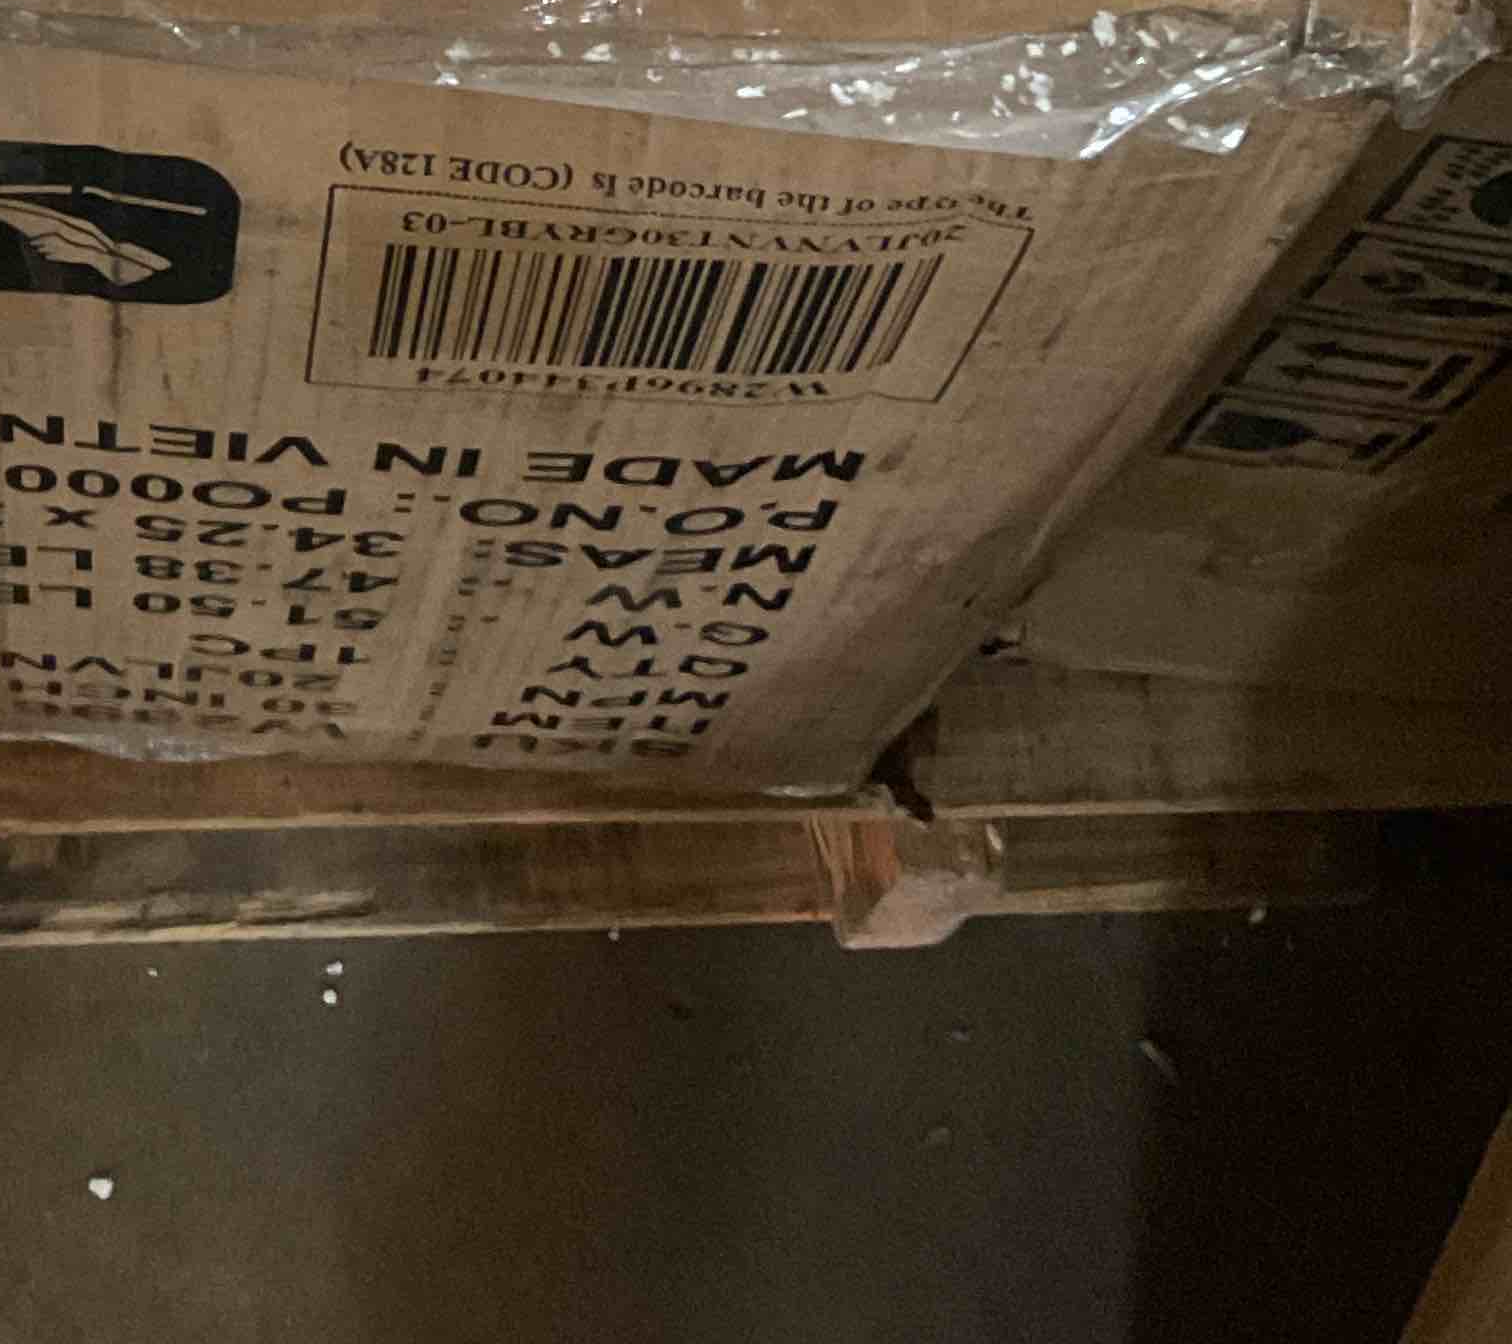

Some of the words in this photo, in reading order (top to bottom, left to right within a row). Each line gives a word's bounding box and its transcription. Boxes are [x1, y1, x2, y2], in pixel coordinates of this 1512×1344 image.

[339, 140, 437, 177] 128A)
[448, 155, 574, 192] (CODE
[628, 176, 767, 209] barcode
[777, 189, 831, 214] the
[837, 197, 875, 216] of
[373, 441, 483, 479] IN
[522, 448, 866, 488] MADE
[135, 514, 405, 558] 34.25
[134, 554, 400, 594] 47.38
[474, 539, 817, 575] MEAS:
[133, 591, 384, 630] 51.50
[188, 633, 370, 665] 1PC
[545, 655, 749, 680] QTY
[520, 685, 731, 710] MPN
[490, 712, 712, 735] ITEM
